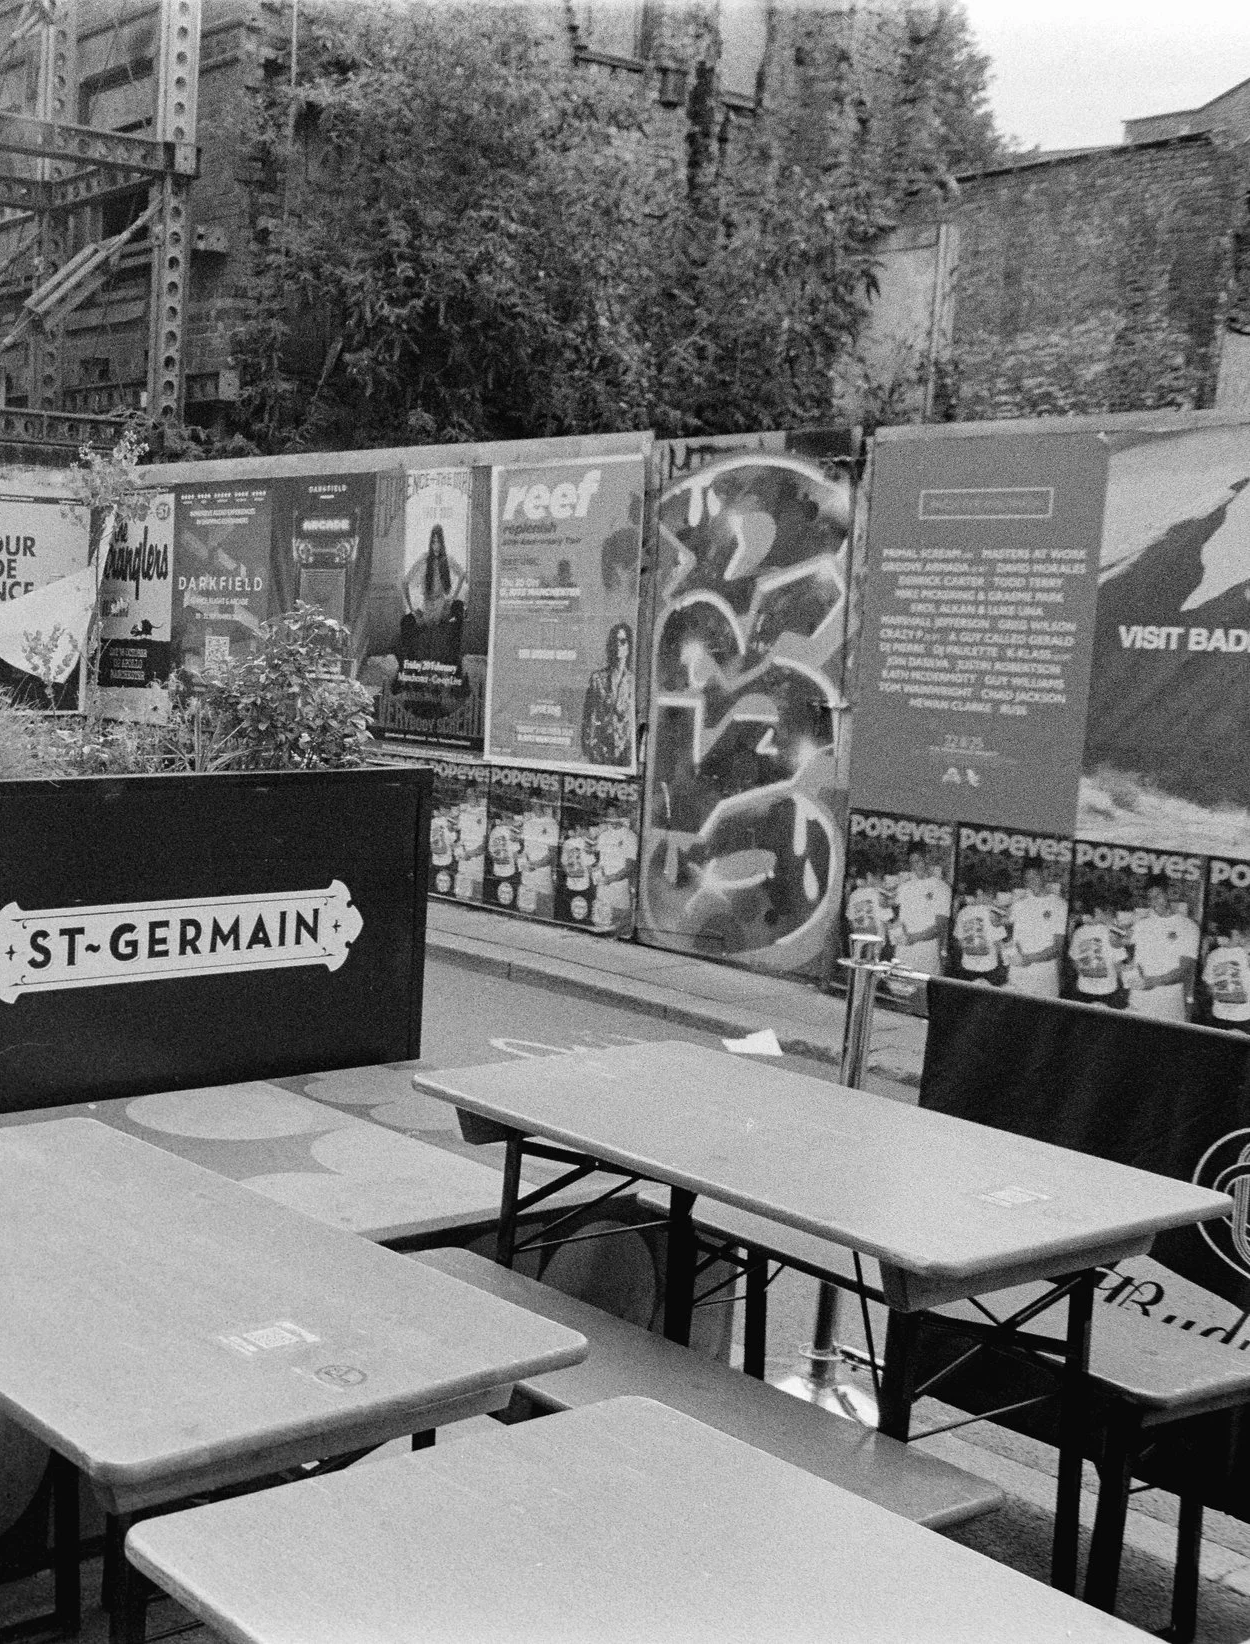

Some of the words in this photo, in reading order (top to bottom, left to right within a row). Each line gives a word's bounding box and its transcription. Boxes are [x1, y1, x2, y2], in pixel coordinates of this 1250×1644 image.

[308, 484, 348, 494] DARKFIELD
[503, 469, 602, 520] reef
[302, 518, 350, 531] ARCADE
[178, 576, 263, 591] DARKFIELD
[1119, 625, 1184, 650] VISIT
[1188, 628, 1250, 653] BAD
